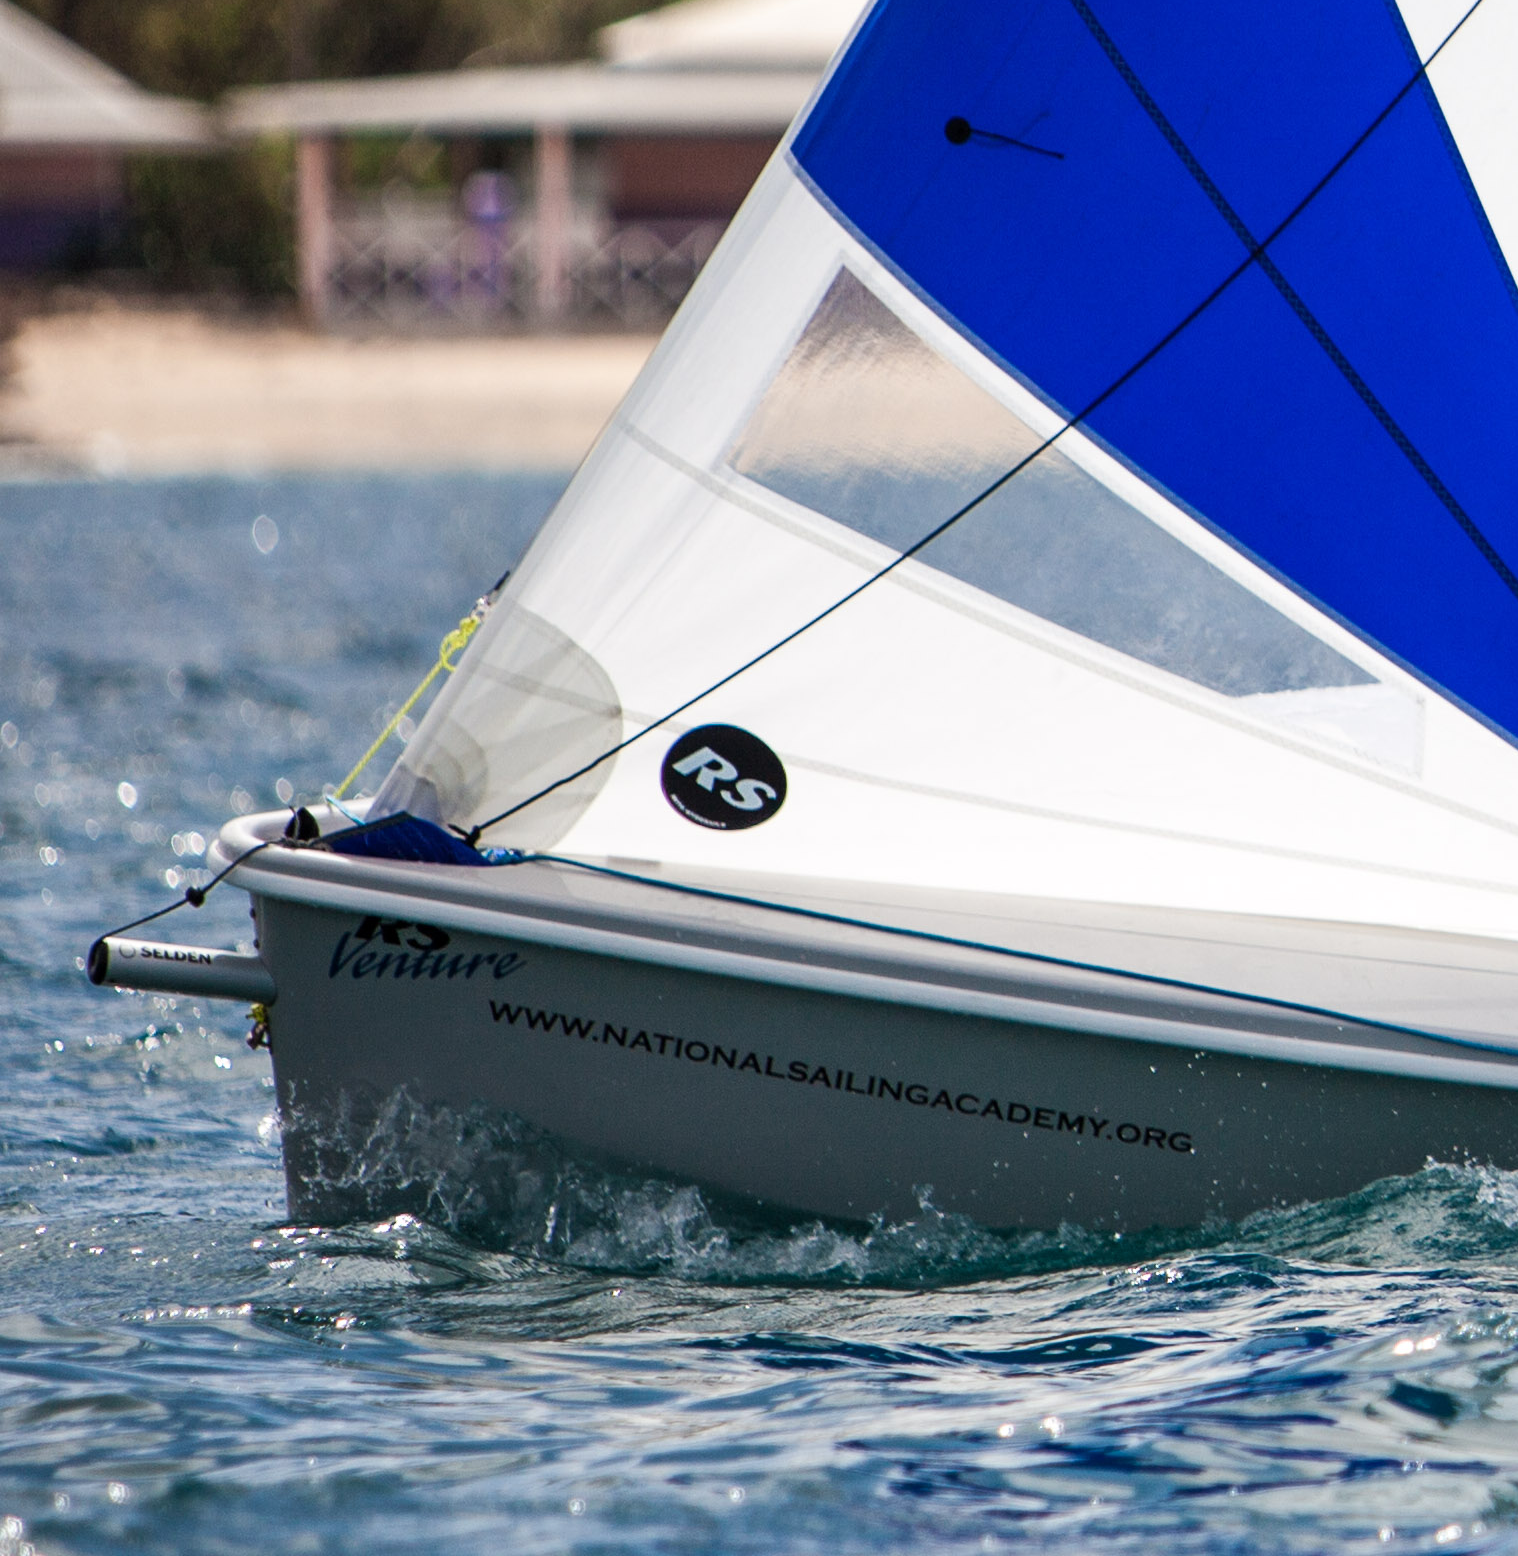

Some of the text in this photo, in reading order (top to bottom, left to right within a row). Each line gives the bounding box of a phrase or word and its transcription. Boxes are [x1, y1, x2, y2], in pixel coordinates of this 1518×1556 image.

[672, 746, 777, 811] RS
[329, 931, 527, 979] Venture
[489, 1000, 1193, 1153] WWW.NATIONALSAILINGACADEMY.ORG
